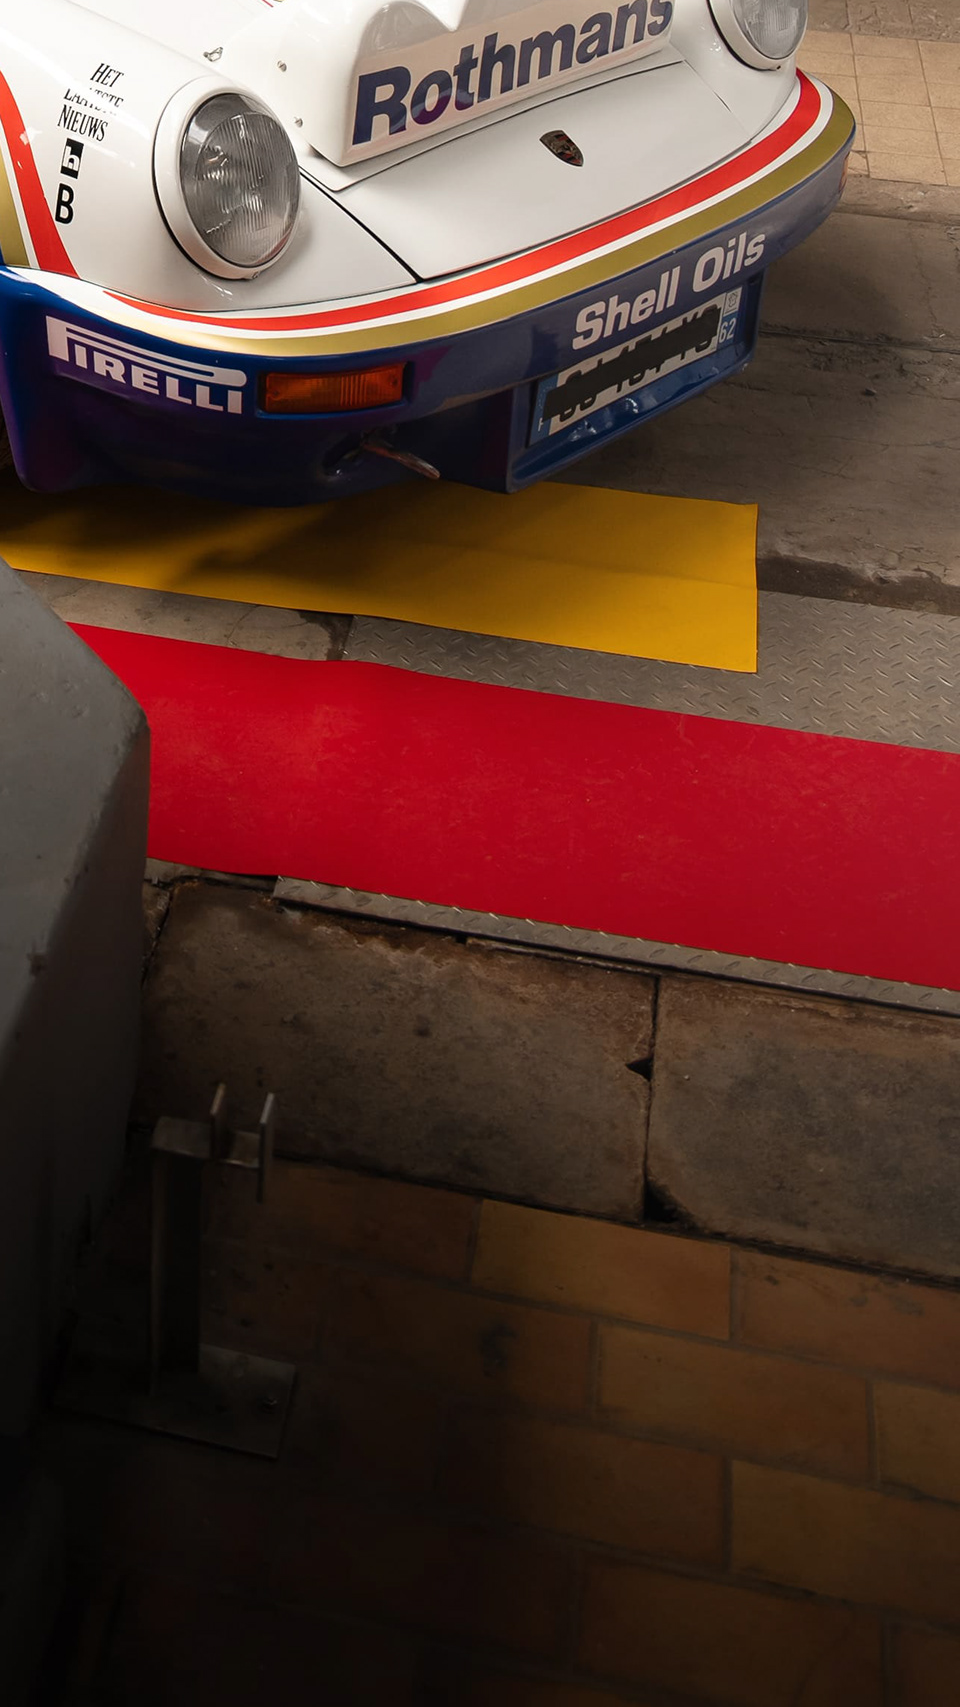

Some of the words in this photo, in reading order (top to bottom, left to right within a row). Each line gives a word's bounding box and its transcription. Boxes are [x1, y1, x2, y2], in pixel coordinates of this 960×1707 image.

[90, 62, 124, 88] HET
[57, 104, 109, 142] NIEUWS
[55, 182, 75, 225] B
[572, 263, 679, 351] Shell
[694, 232, 766, 293] Oils
[718, 317, 737, 344] 62
[45, 314, 247, 415] PIRELLI
